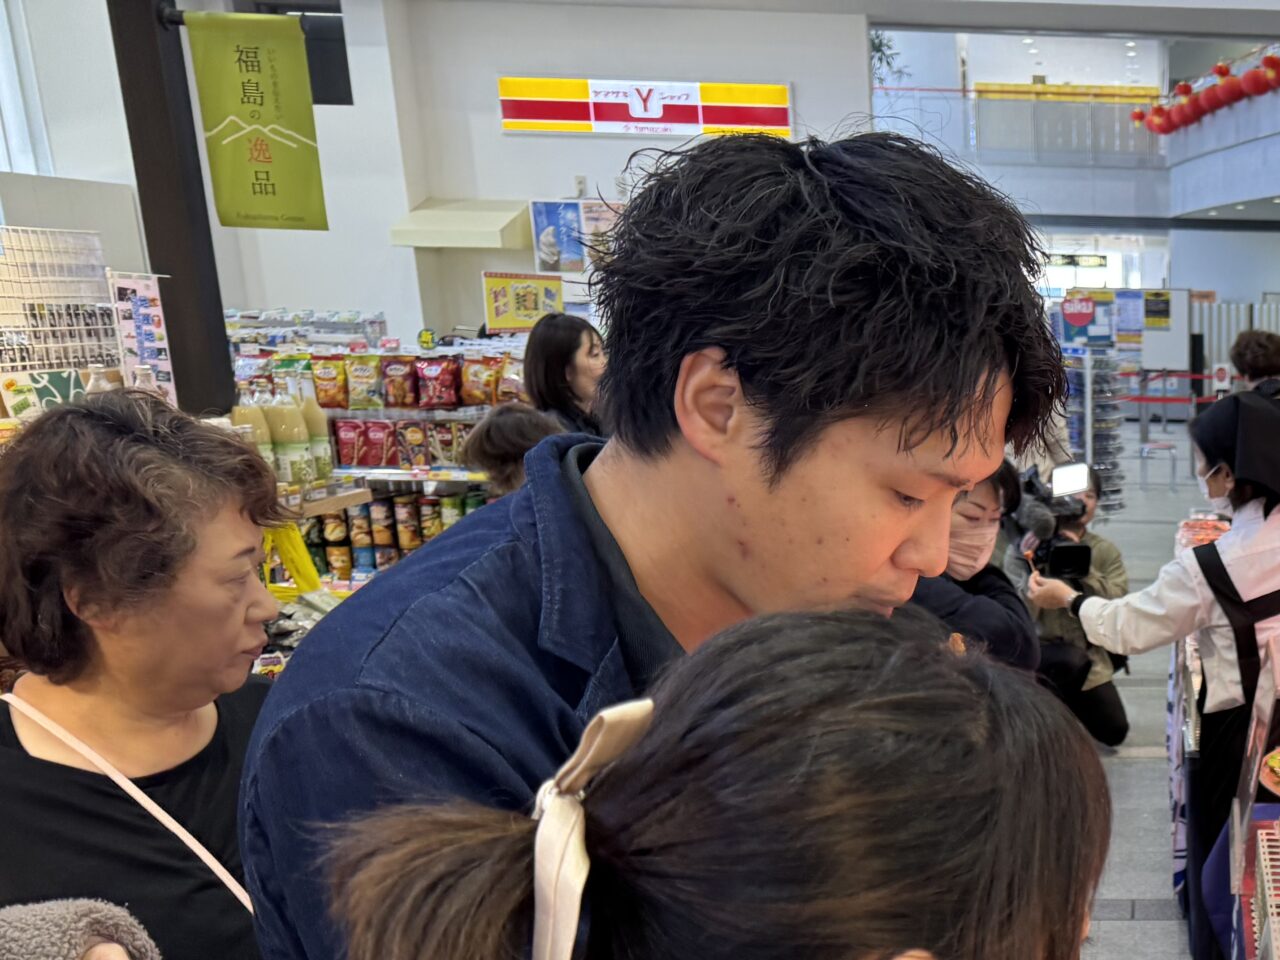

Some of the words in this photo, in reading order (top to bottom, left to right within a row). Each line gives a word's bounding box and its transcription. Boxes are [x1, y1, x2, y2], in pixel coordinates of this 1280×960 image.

[234, 45, 276, 196] 福島の逸品
[635, 86, 654, 113] Y
